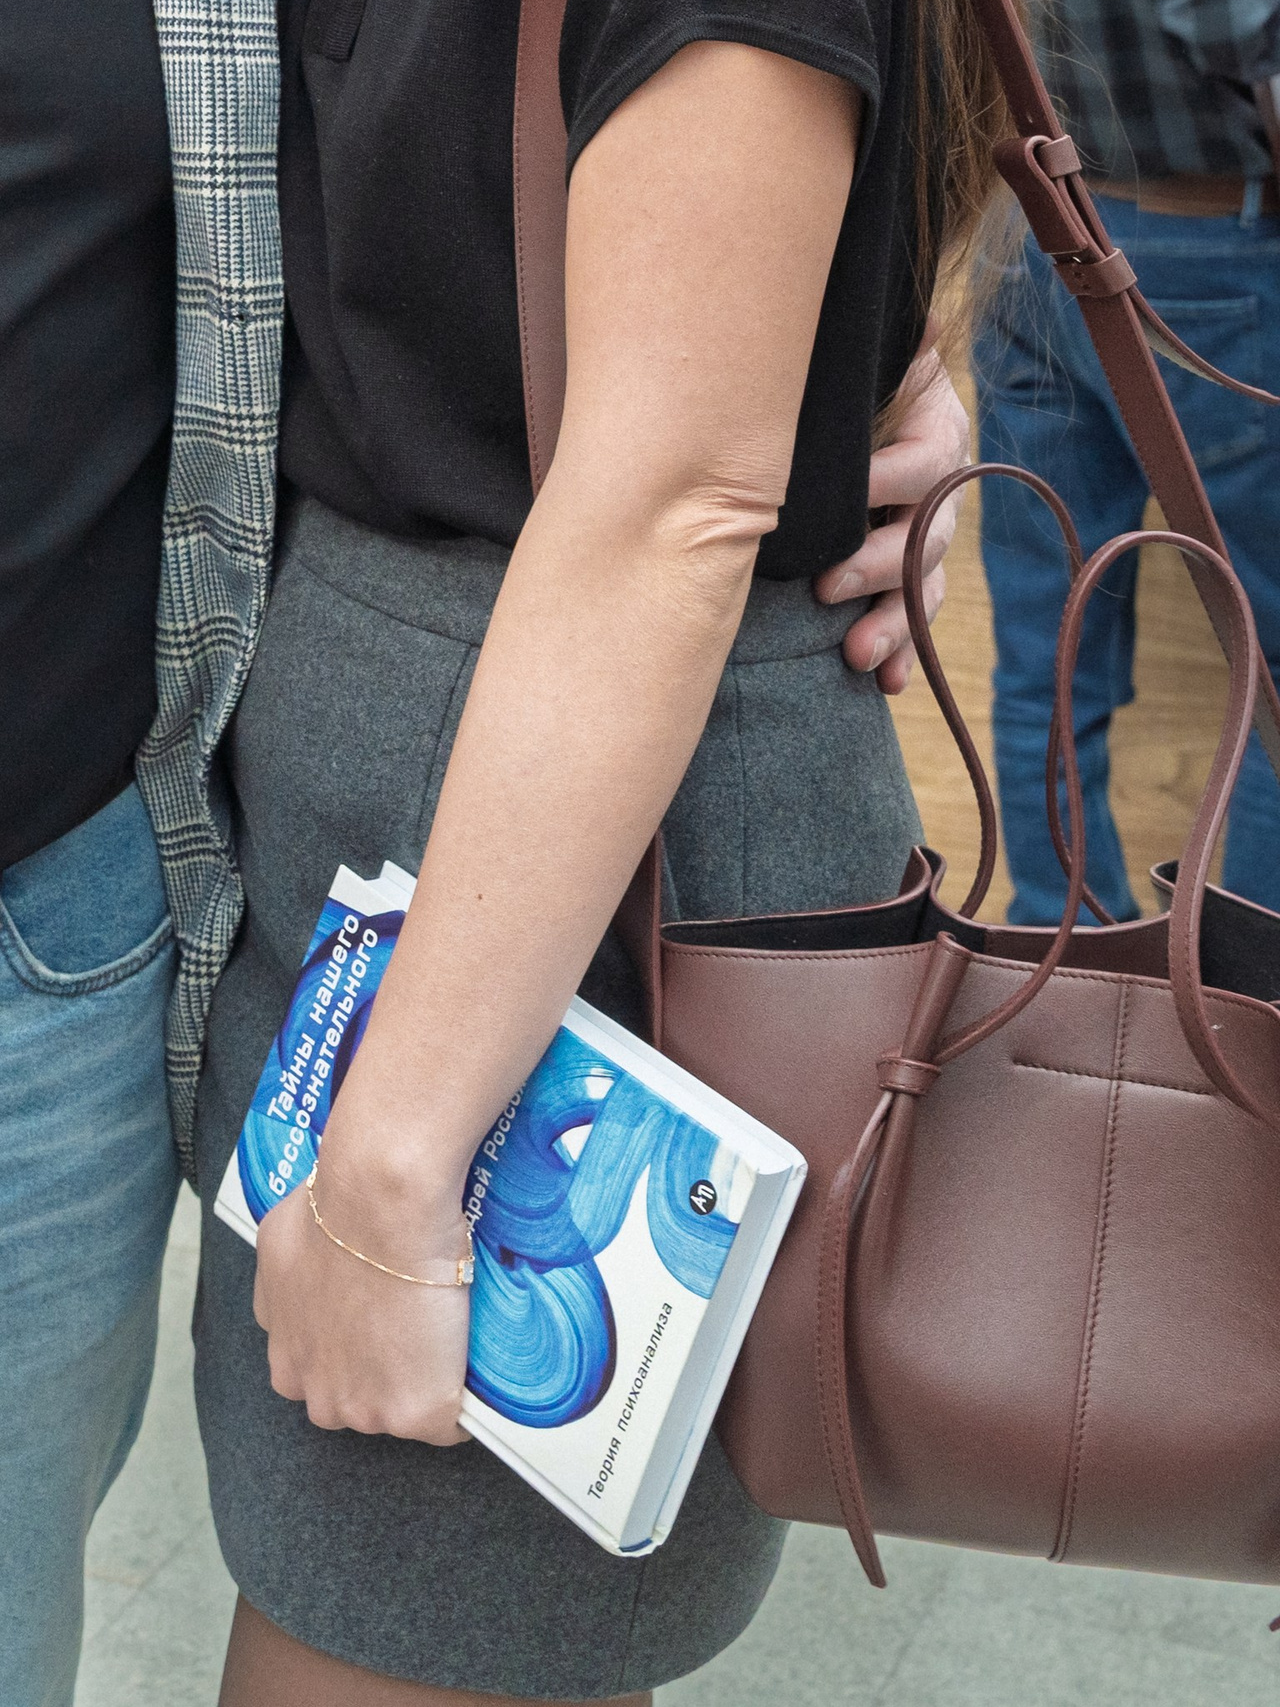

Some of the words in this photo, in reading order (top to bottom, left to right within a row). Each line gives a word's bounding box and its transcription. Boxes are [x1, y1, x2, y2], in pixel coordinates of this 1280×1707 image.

[267, 1032, 316, 1122] Тайны
[308, 914, 360, 1025] нашего
[267, 928, 379, 1197] бессознательного
[465, 1166, 492, 1233] дрей
[483, 1083, 526, 1161] Россо
[586, 1436, 622, 1501] Теория
[616, 1301, 674, 1433] психоанализа
